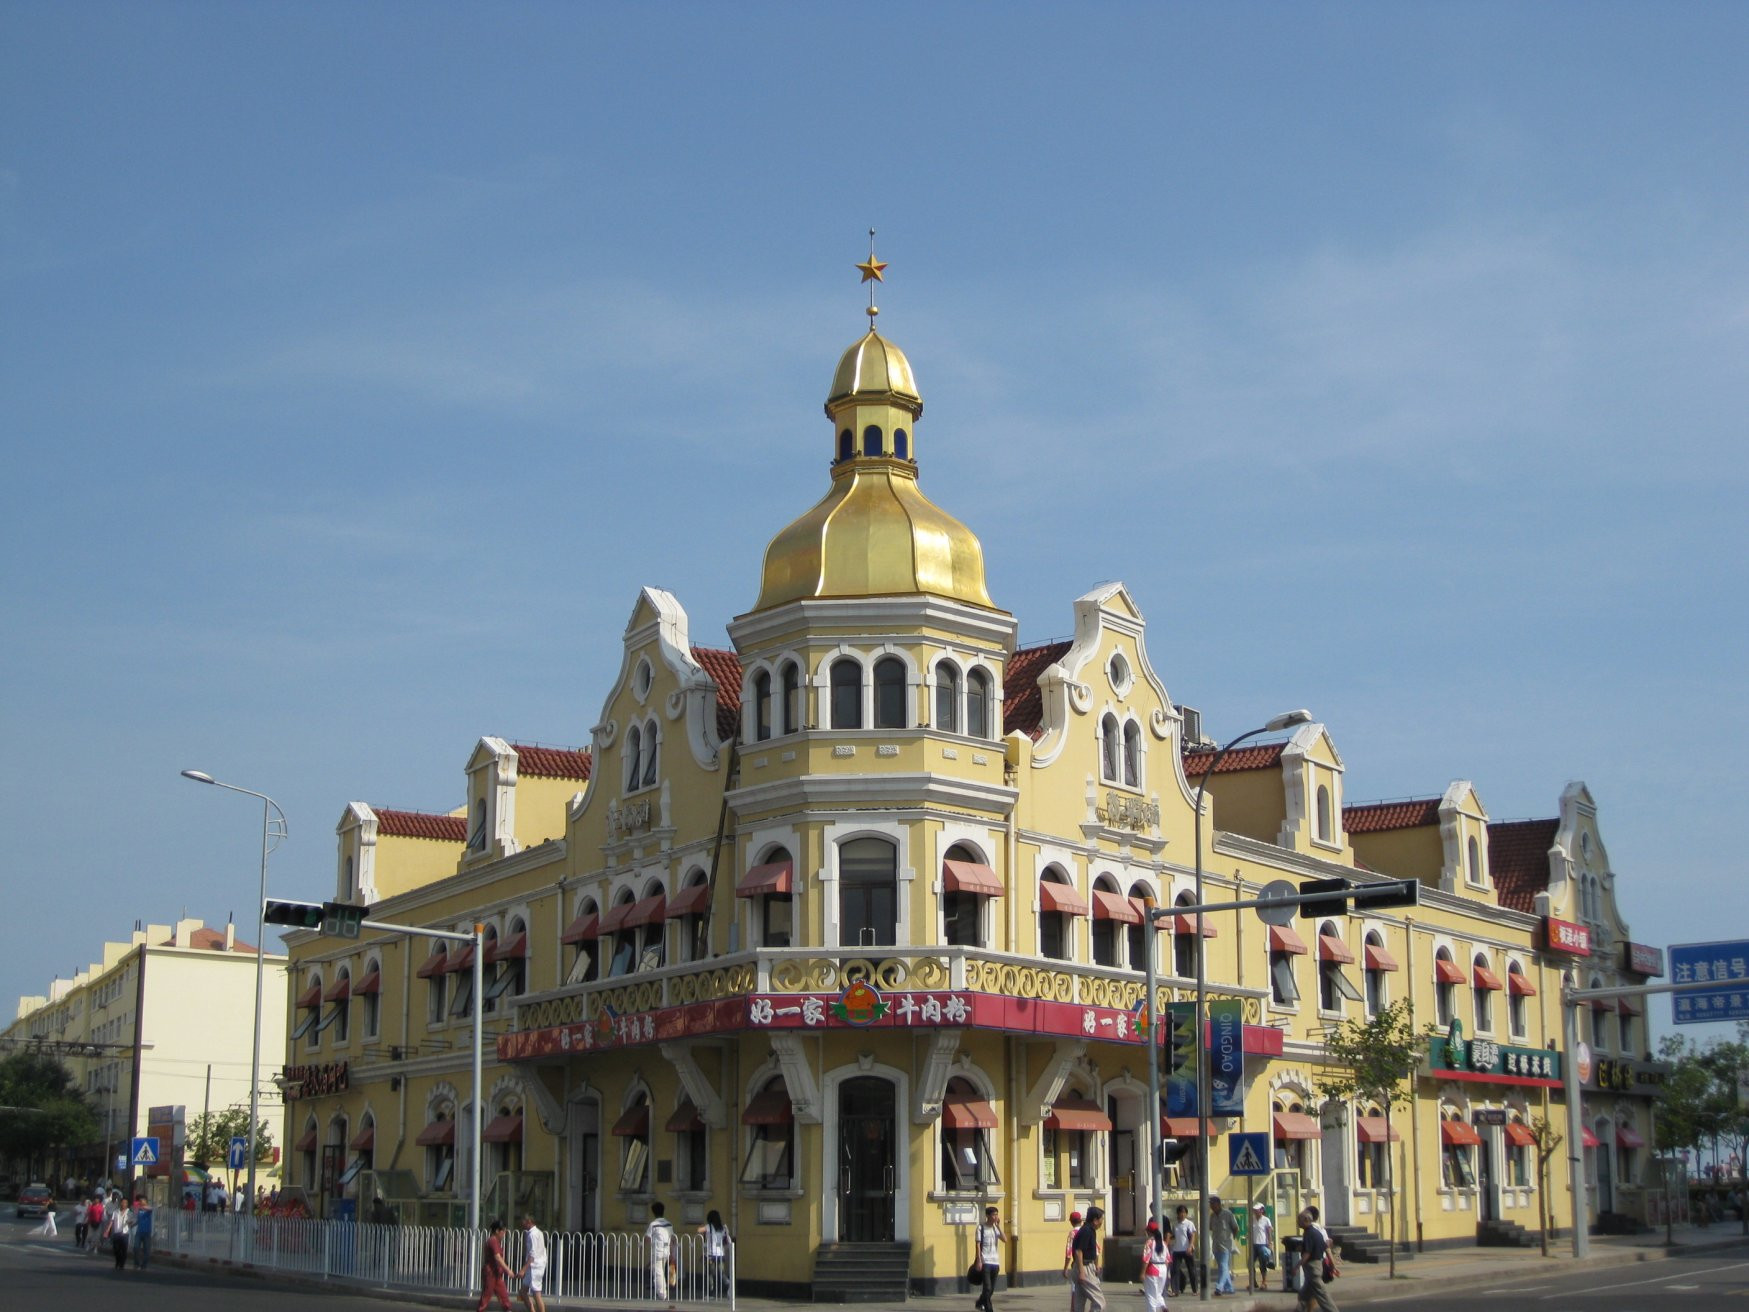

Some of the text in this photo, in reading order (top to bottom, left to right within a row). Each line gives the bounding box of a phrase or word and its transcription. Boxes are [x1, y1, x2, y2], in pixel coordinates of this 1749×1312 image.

[1676, 957, 1746, 982] 注意信号
[751, 993, 972, 1025] 好一家 牛肉粉
[1083, 1008, 1128, 1039] 好一家
[561, 1014, 655, 1050] 好一家 牛肉粉
[1220, 1012, 1234, 1073] QINGDAO
